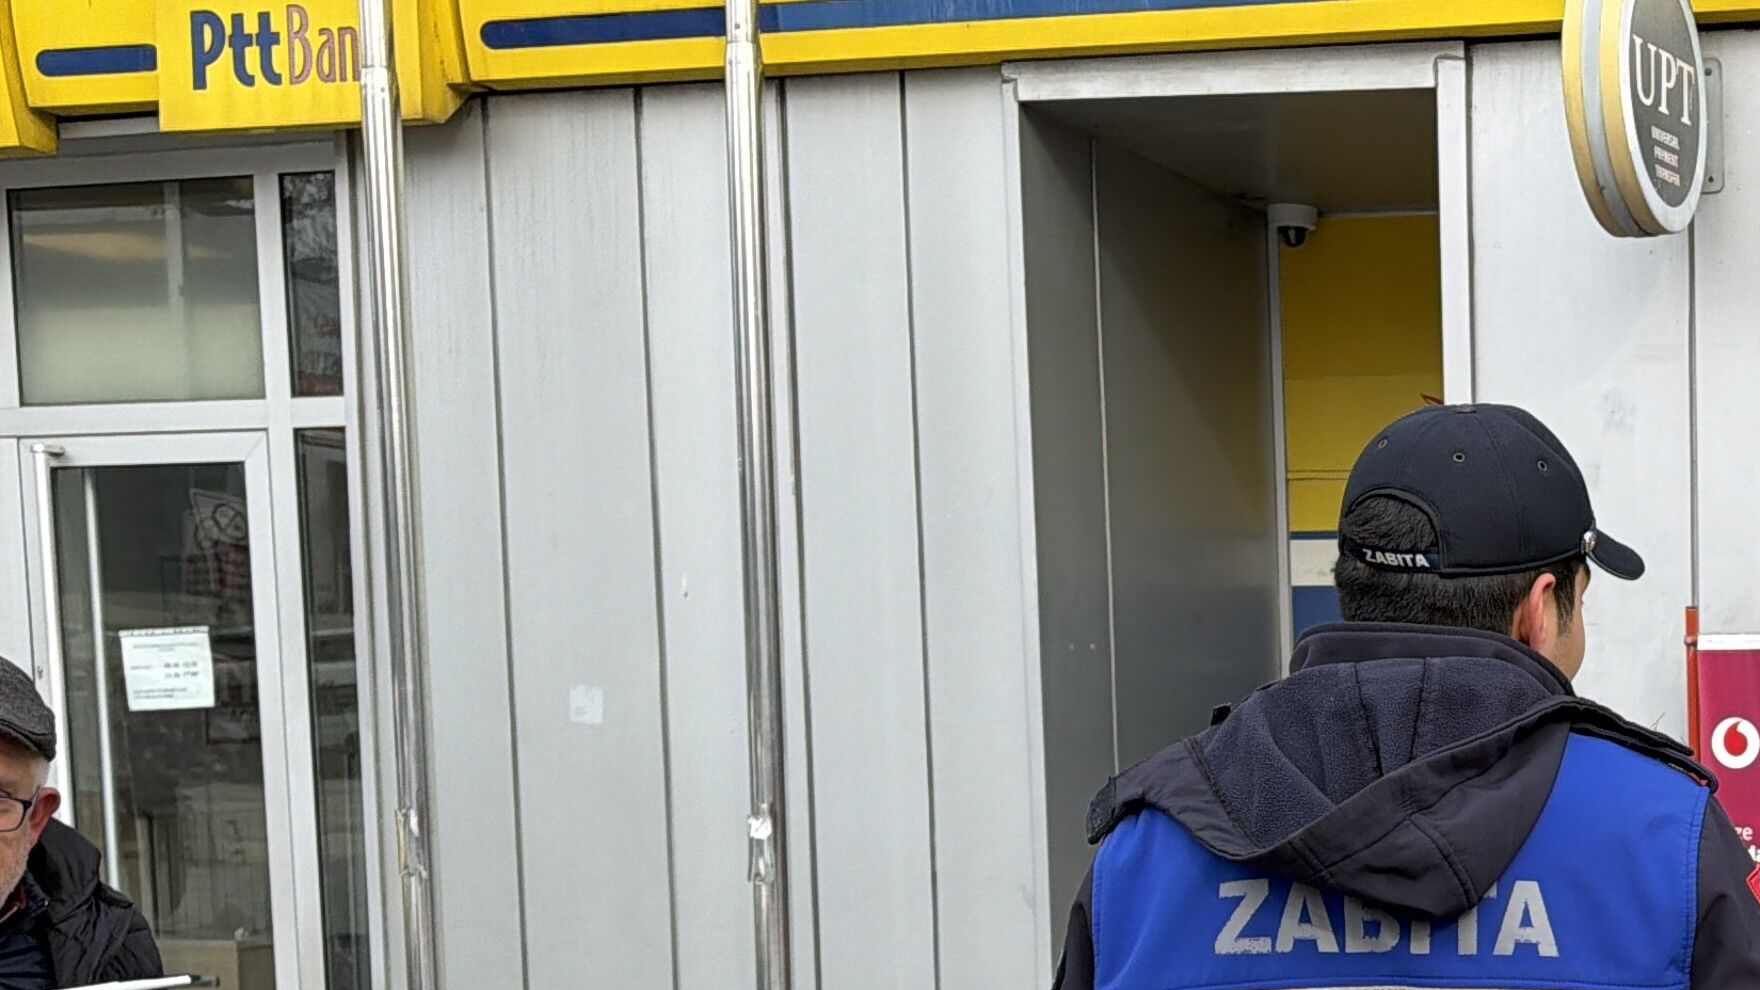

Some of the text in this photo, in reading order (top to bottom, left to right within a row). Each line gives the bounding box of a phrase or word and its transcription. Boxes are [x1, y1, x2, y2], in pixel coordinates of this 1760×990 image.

[189, 4, 361, 91] PttBan
[1632, 34, 1695, 126] UPT
[1362, 548, 1431, 568] ZABITA
